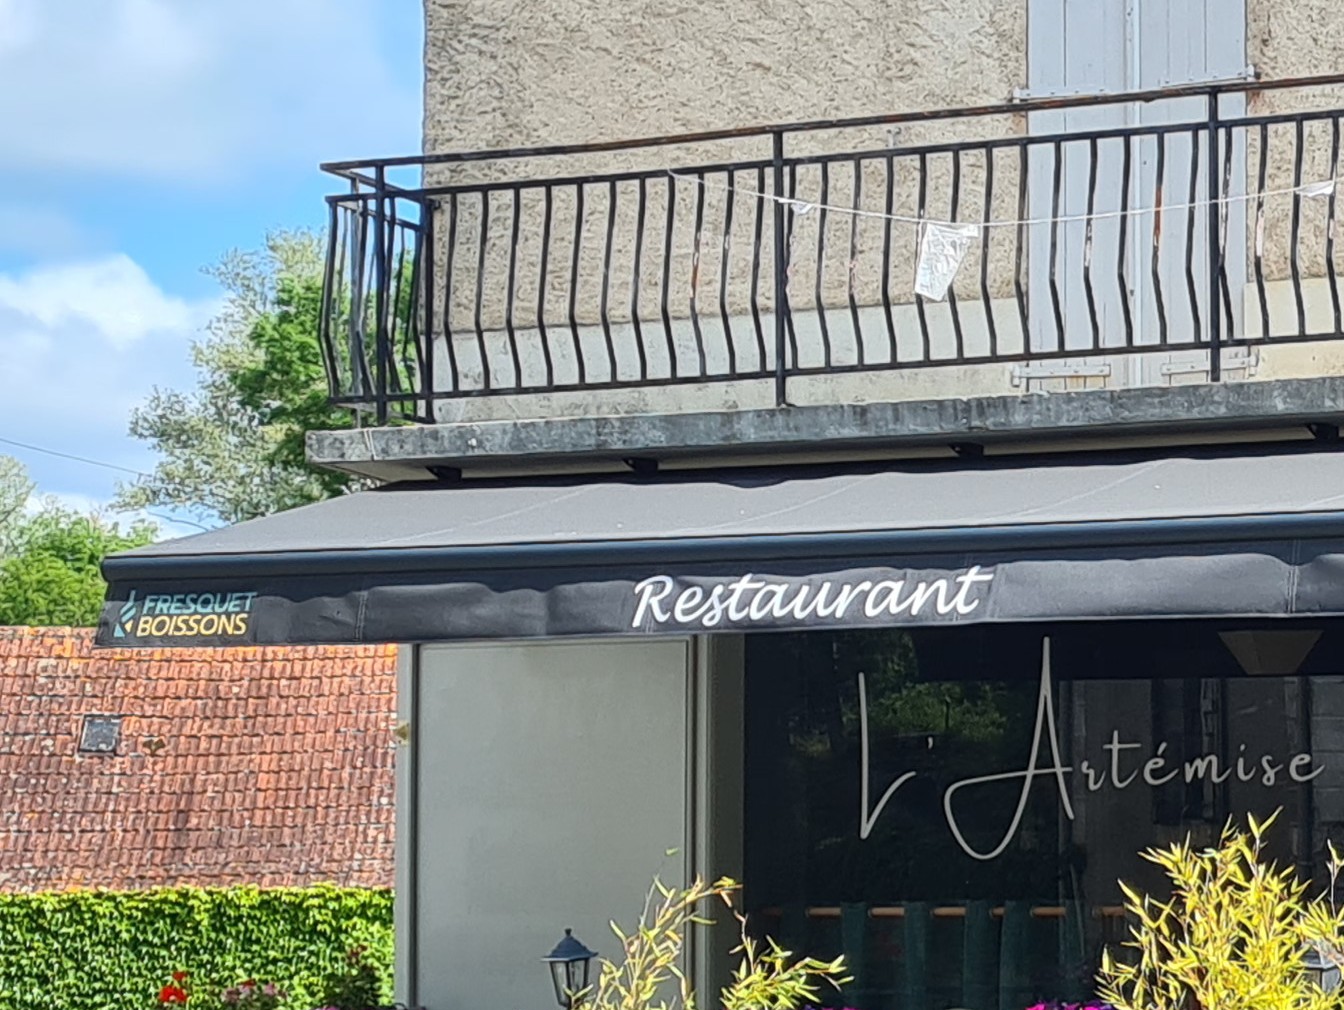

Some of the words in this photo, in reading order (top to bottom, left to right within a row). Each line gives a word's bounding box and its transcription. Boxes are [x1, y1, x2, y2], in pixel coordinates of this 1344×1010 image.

[142, 591, 258, 615] FRESQUET
[631, 565, 994, 628] Restaurant
[136, 612, 249, 637] BOISSONS
[858, 636, 1326, 861] L'Artémise
